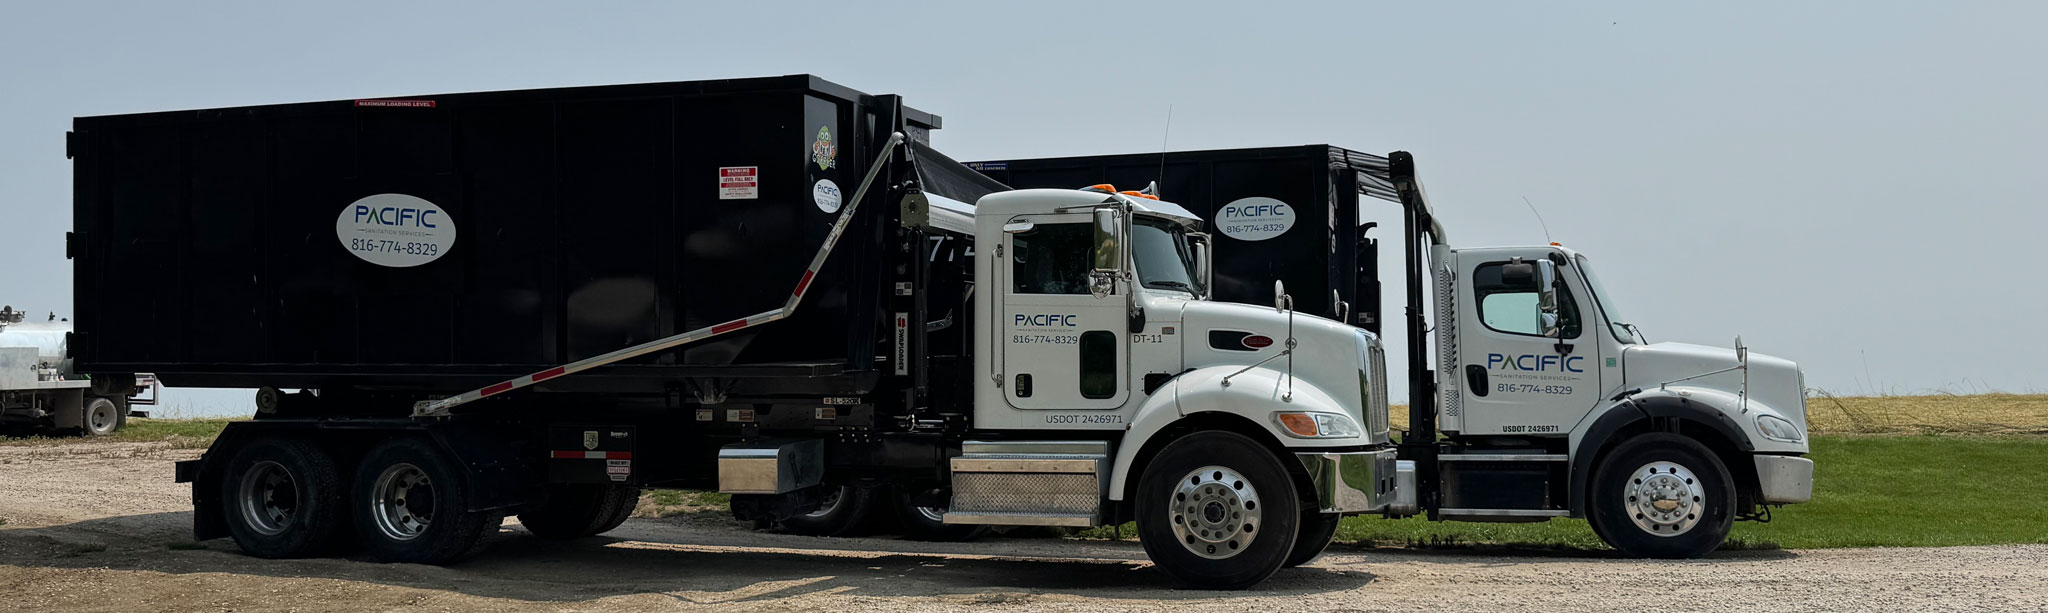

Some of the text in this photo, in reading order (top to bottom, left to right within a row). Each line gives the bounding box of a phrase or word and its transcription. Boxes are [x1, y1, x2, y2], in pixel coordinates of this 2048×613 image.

[817, 184, 838, 197] PACIFIC
[355, 205, 437, 228] PACIFIC
[1226, 204, 1285, 217] PACIFIC
[364, 227, 426, 237] SANITATION SERVICES
[1226, 224, 1285, 233] 816-774-8329
[351, 238, 438, 256] 816-774-8329
[1014, 314, 1077, 327] PACIFIC
[1012, 335, 1079, 345] 816-774-8329
[1133, 334, 1163, 344] DT-11
[1487, 353, 1584, 373] PACIFIC
[1497, 383, 1573, 395] 816-774-8329
[1046, 414, 1123, 424] USDOT 2426971
[1502, 425, 1559, 433] USDOT 2426971
